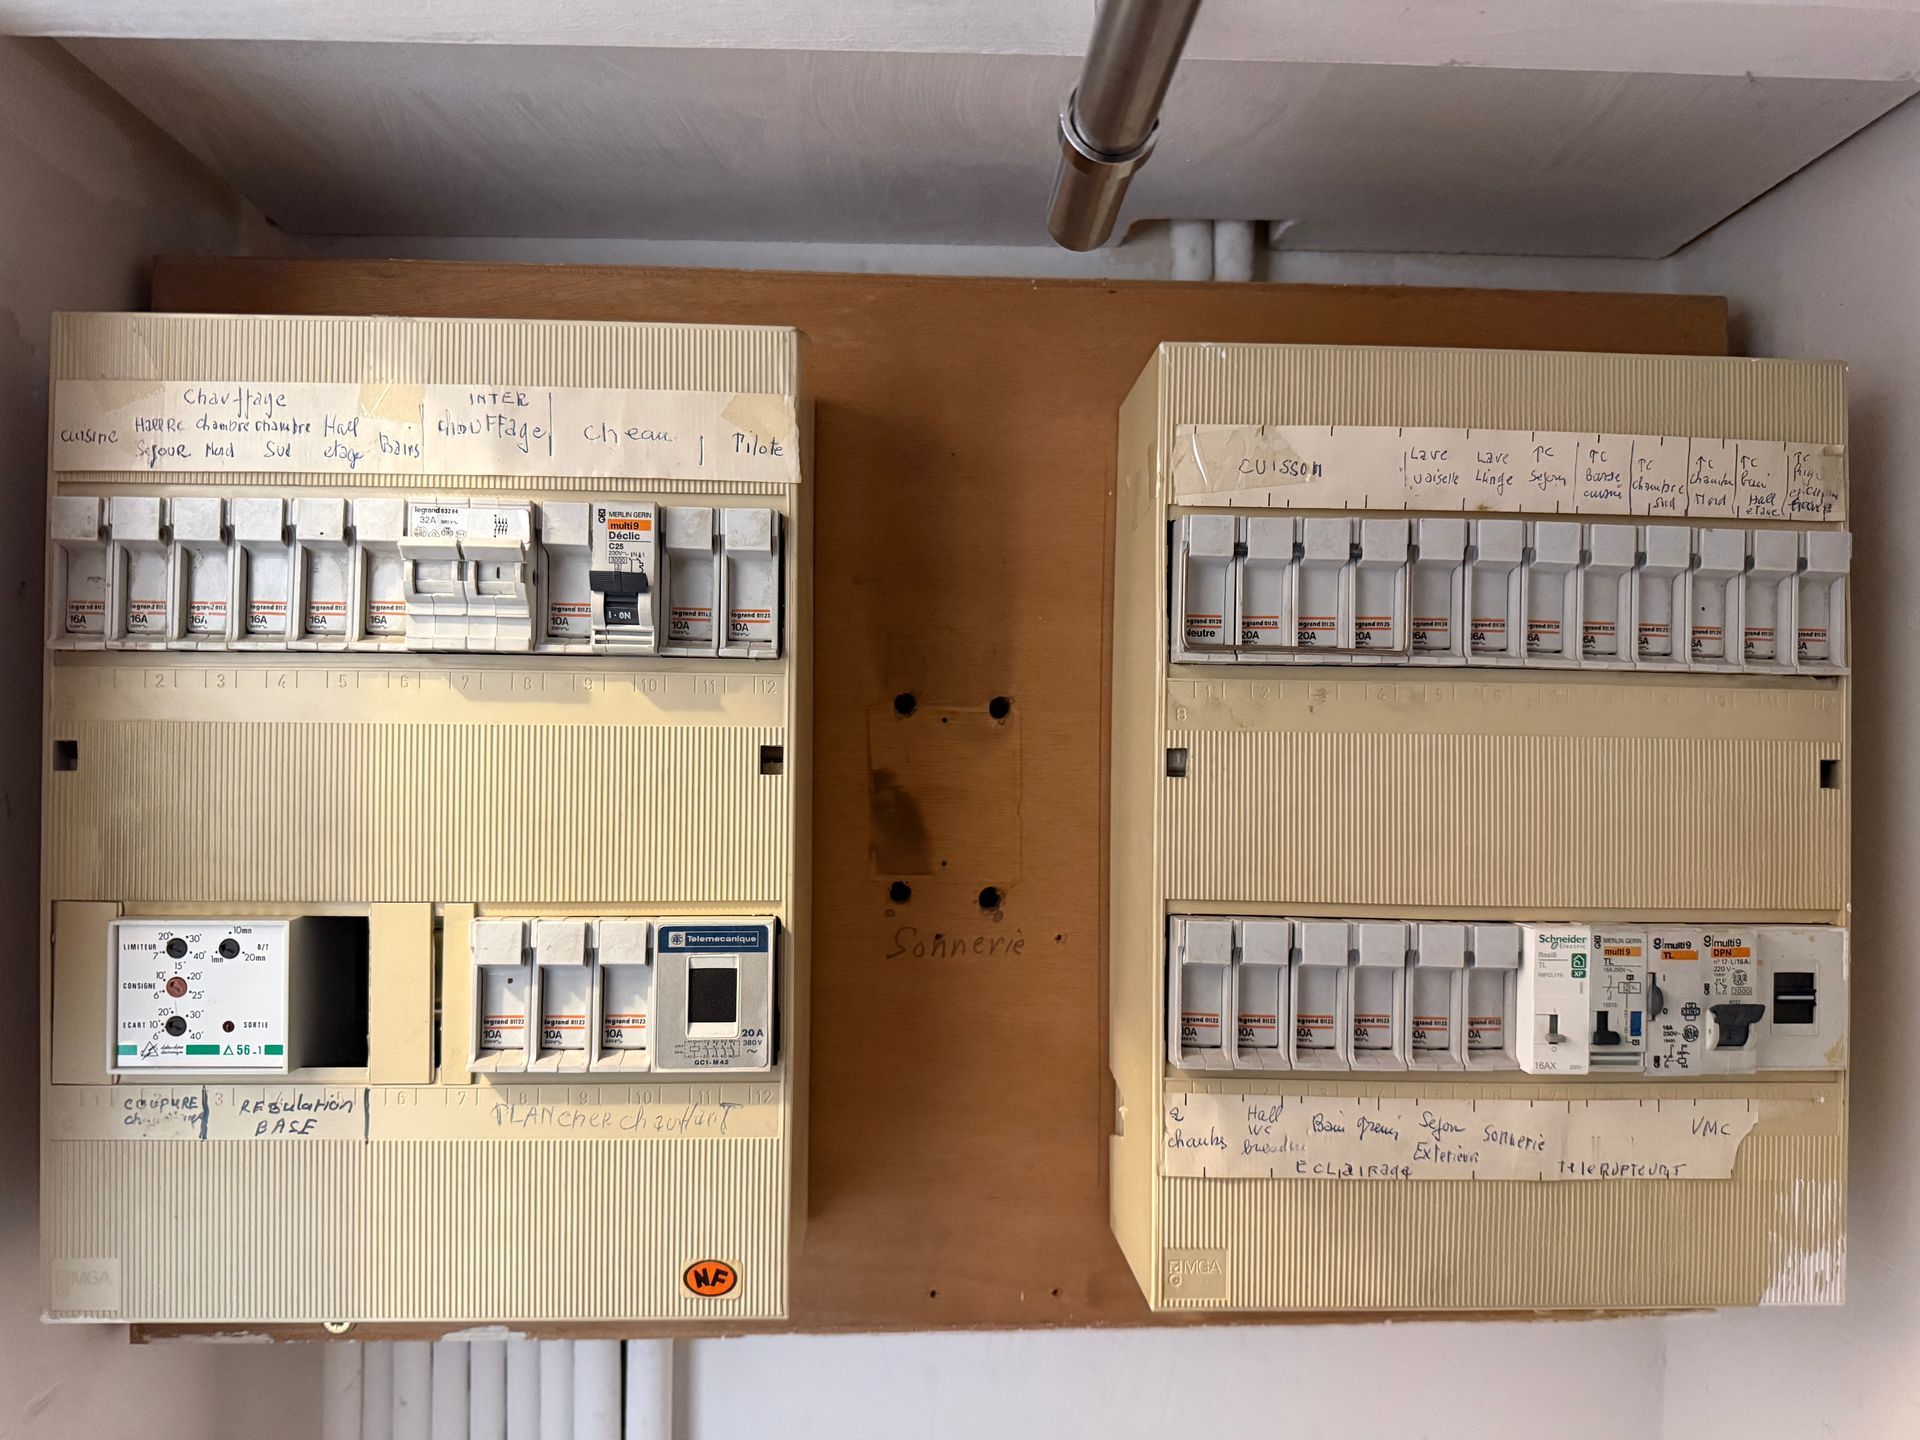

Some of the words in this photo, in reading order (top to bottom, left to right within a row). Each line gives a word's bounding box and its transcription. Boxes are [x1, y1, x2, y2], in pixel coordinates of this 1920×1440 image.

[470, 392, 529, 407] INTER
[324, 415, 359, 437] Hall
[264, 441, 292, 458] Sud
[1410, 447, 1448, 461] Lave
[1477, 452, 1509, 464] Lave
[415, 506, 440, 514] legrand
[420, 516, 436, 524] 32A
[609, 532, 640, 540] Déclic
[69, 615, 86, 624] 16A
[130, 615, 148, 623] 16A
[250, 615, 267, 624] 16A
[310, 615, 327, 624] 16A
[370, 615, 387, 624] 16A
[619, 611, 631, 619] ON
[551, 617, 569, 626] 10A
[672, 622, 690, 630] 10A
[731, 623, 748, 631] 10A
[155, 674, 165, 688] 2
[217, 674, 225, 688] 3
[277, 674, 286, 688] 4
[338, 674, 347, 688] 5
[400, 674, 409, 688] 6
[461, 676, 470, 690] 7
[523, 676, 532, 690] 8
[584, 676, 592, 690] 9
[641, 677, 657, 692] 10
[760, 679, 777, 693] 12
[233, 926, 252, 934] 10mn
[688, 935, 756, 943] Telemecanique
[1539, 934, 1587, 944] Schneider
[1714, 949, 1732, 957] DPN
[211, 955, 223, 963] 1mn
[483, 1030, 502, 1039] 10A
[544, 1030, 562, 1039] 10A
[605, 1030, 623, 1038] 10A
[1535, 1062, 1557, 1070] 16AX
[1248, 1105, 1282, 1123] Hall
[255, 1118, 318, 1136] BASE
[1692, 1116, 1731, 1137] VMC
[1184, 1260, 1222, 1275] MGA
[694, 1267, 728, 1288] NF
